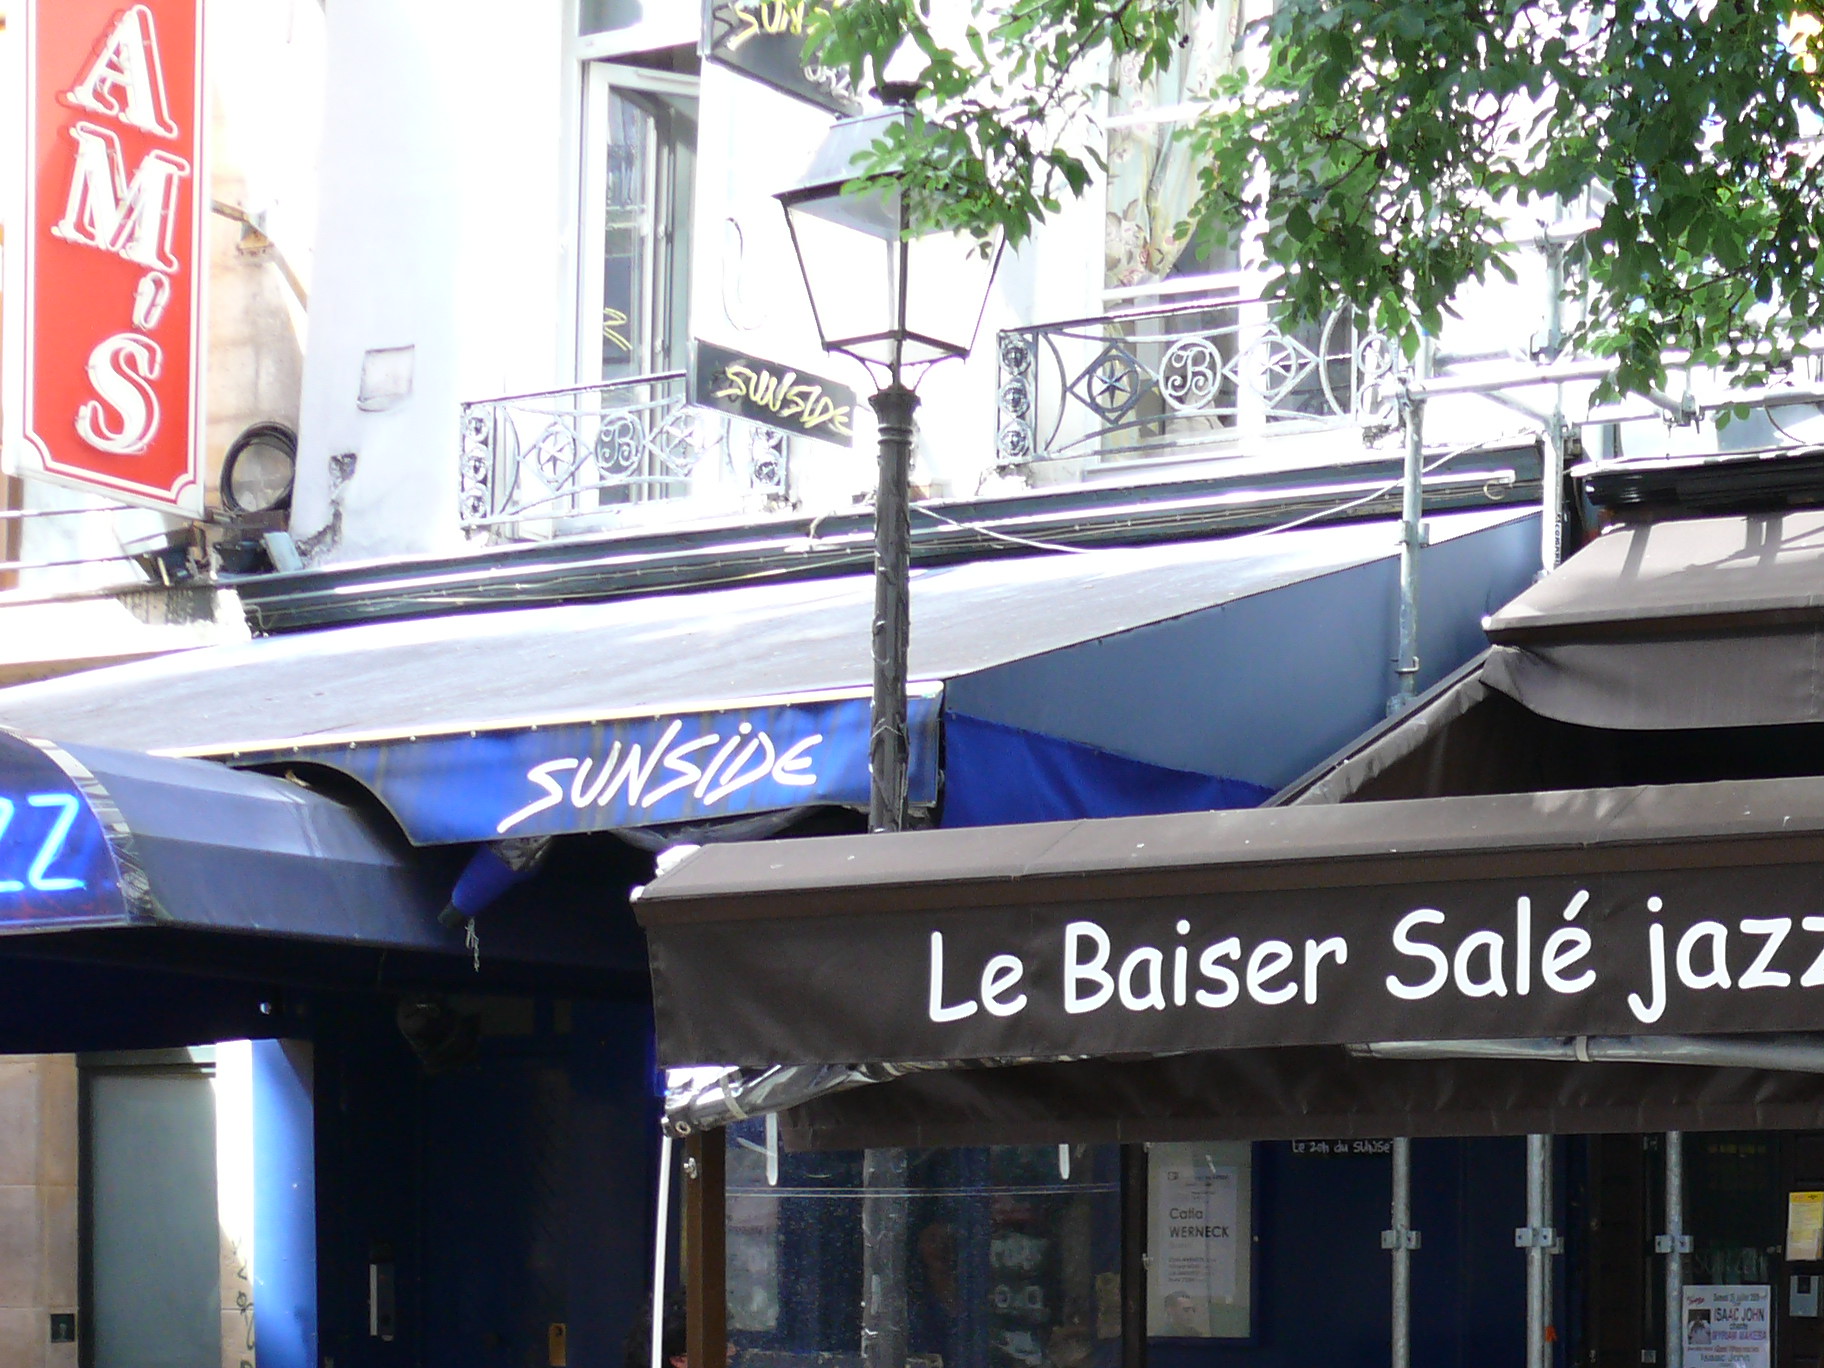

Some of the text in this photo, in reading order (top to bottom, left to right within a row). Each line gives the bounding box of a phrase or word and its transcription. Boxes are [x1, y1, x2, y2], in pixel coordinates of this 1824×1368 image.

[496, 719, 823, 834] SUNSIDE
[929, 930, 1028, 1024] Le
[1063, 918, 1348, 1016] Baiser
[1385, 889, 1597, 1002] Salé
[1741, 1307, 1766, 1322] JOHN
